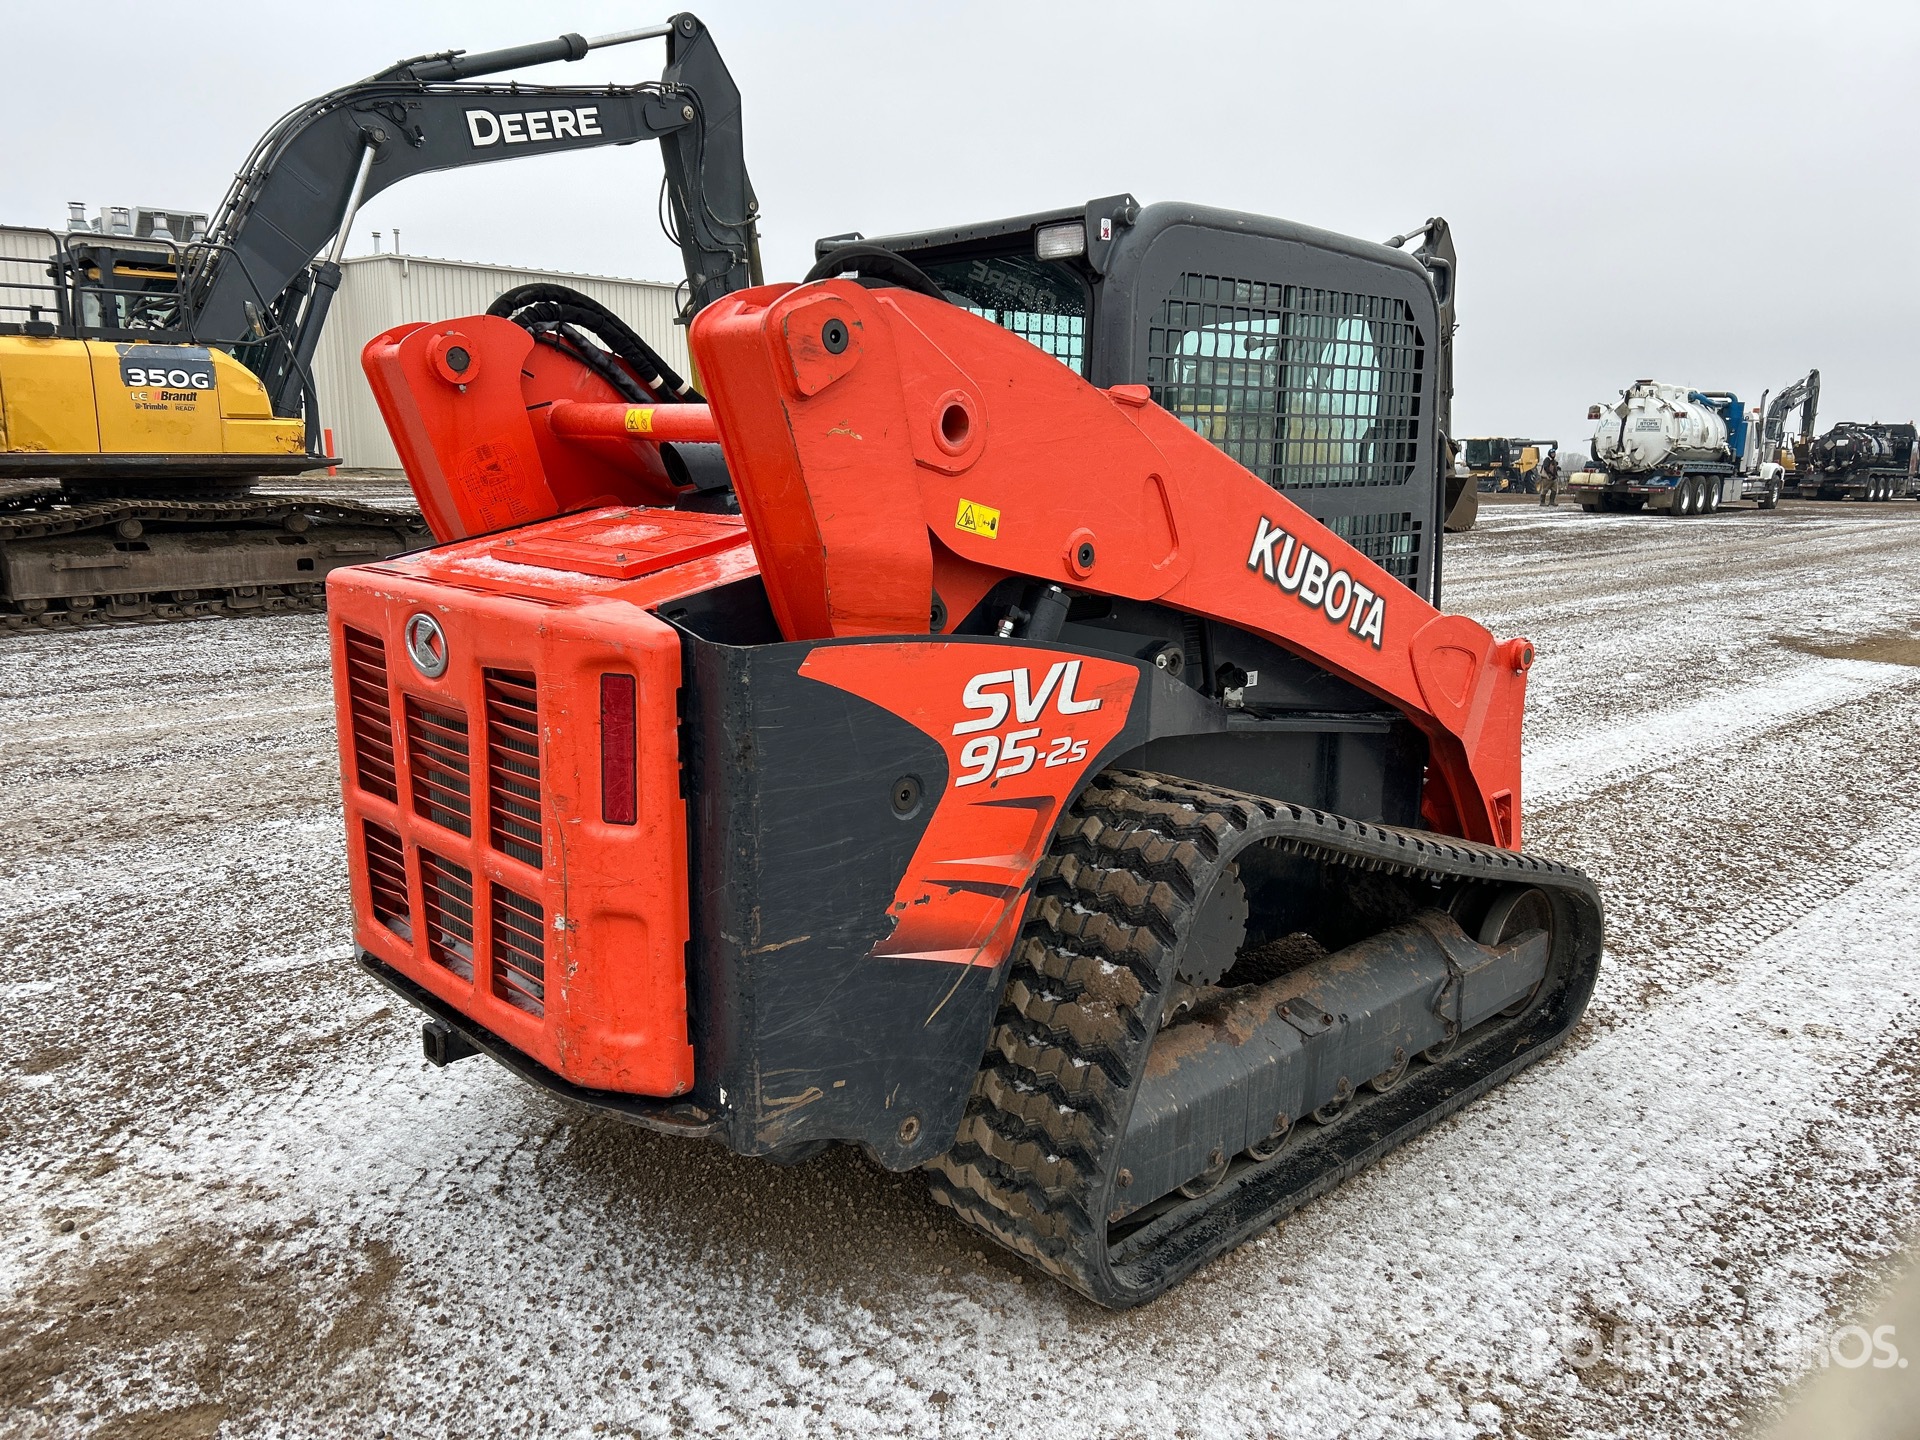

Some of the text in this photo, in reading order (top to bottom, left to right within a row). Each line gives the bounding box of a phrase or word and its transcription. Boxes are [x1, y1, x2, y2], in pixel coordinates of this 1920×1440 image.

[465, 107, 602, 146] DEERE
[127, 368, 209, 389] 350G
[131, 392, 148, 401] LC
[160, 391, 197, 401] Brandt
[143, 403, 168, 411] Trimble
[1248, 516, 1385, 647] KUBOTA
[952, 660, 1103, 735] SVL
